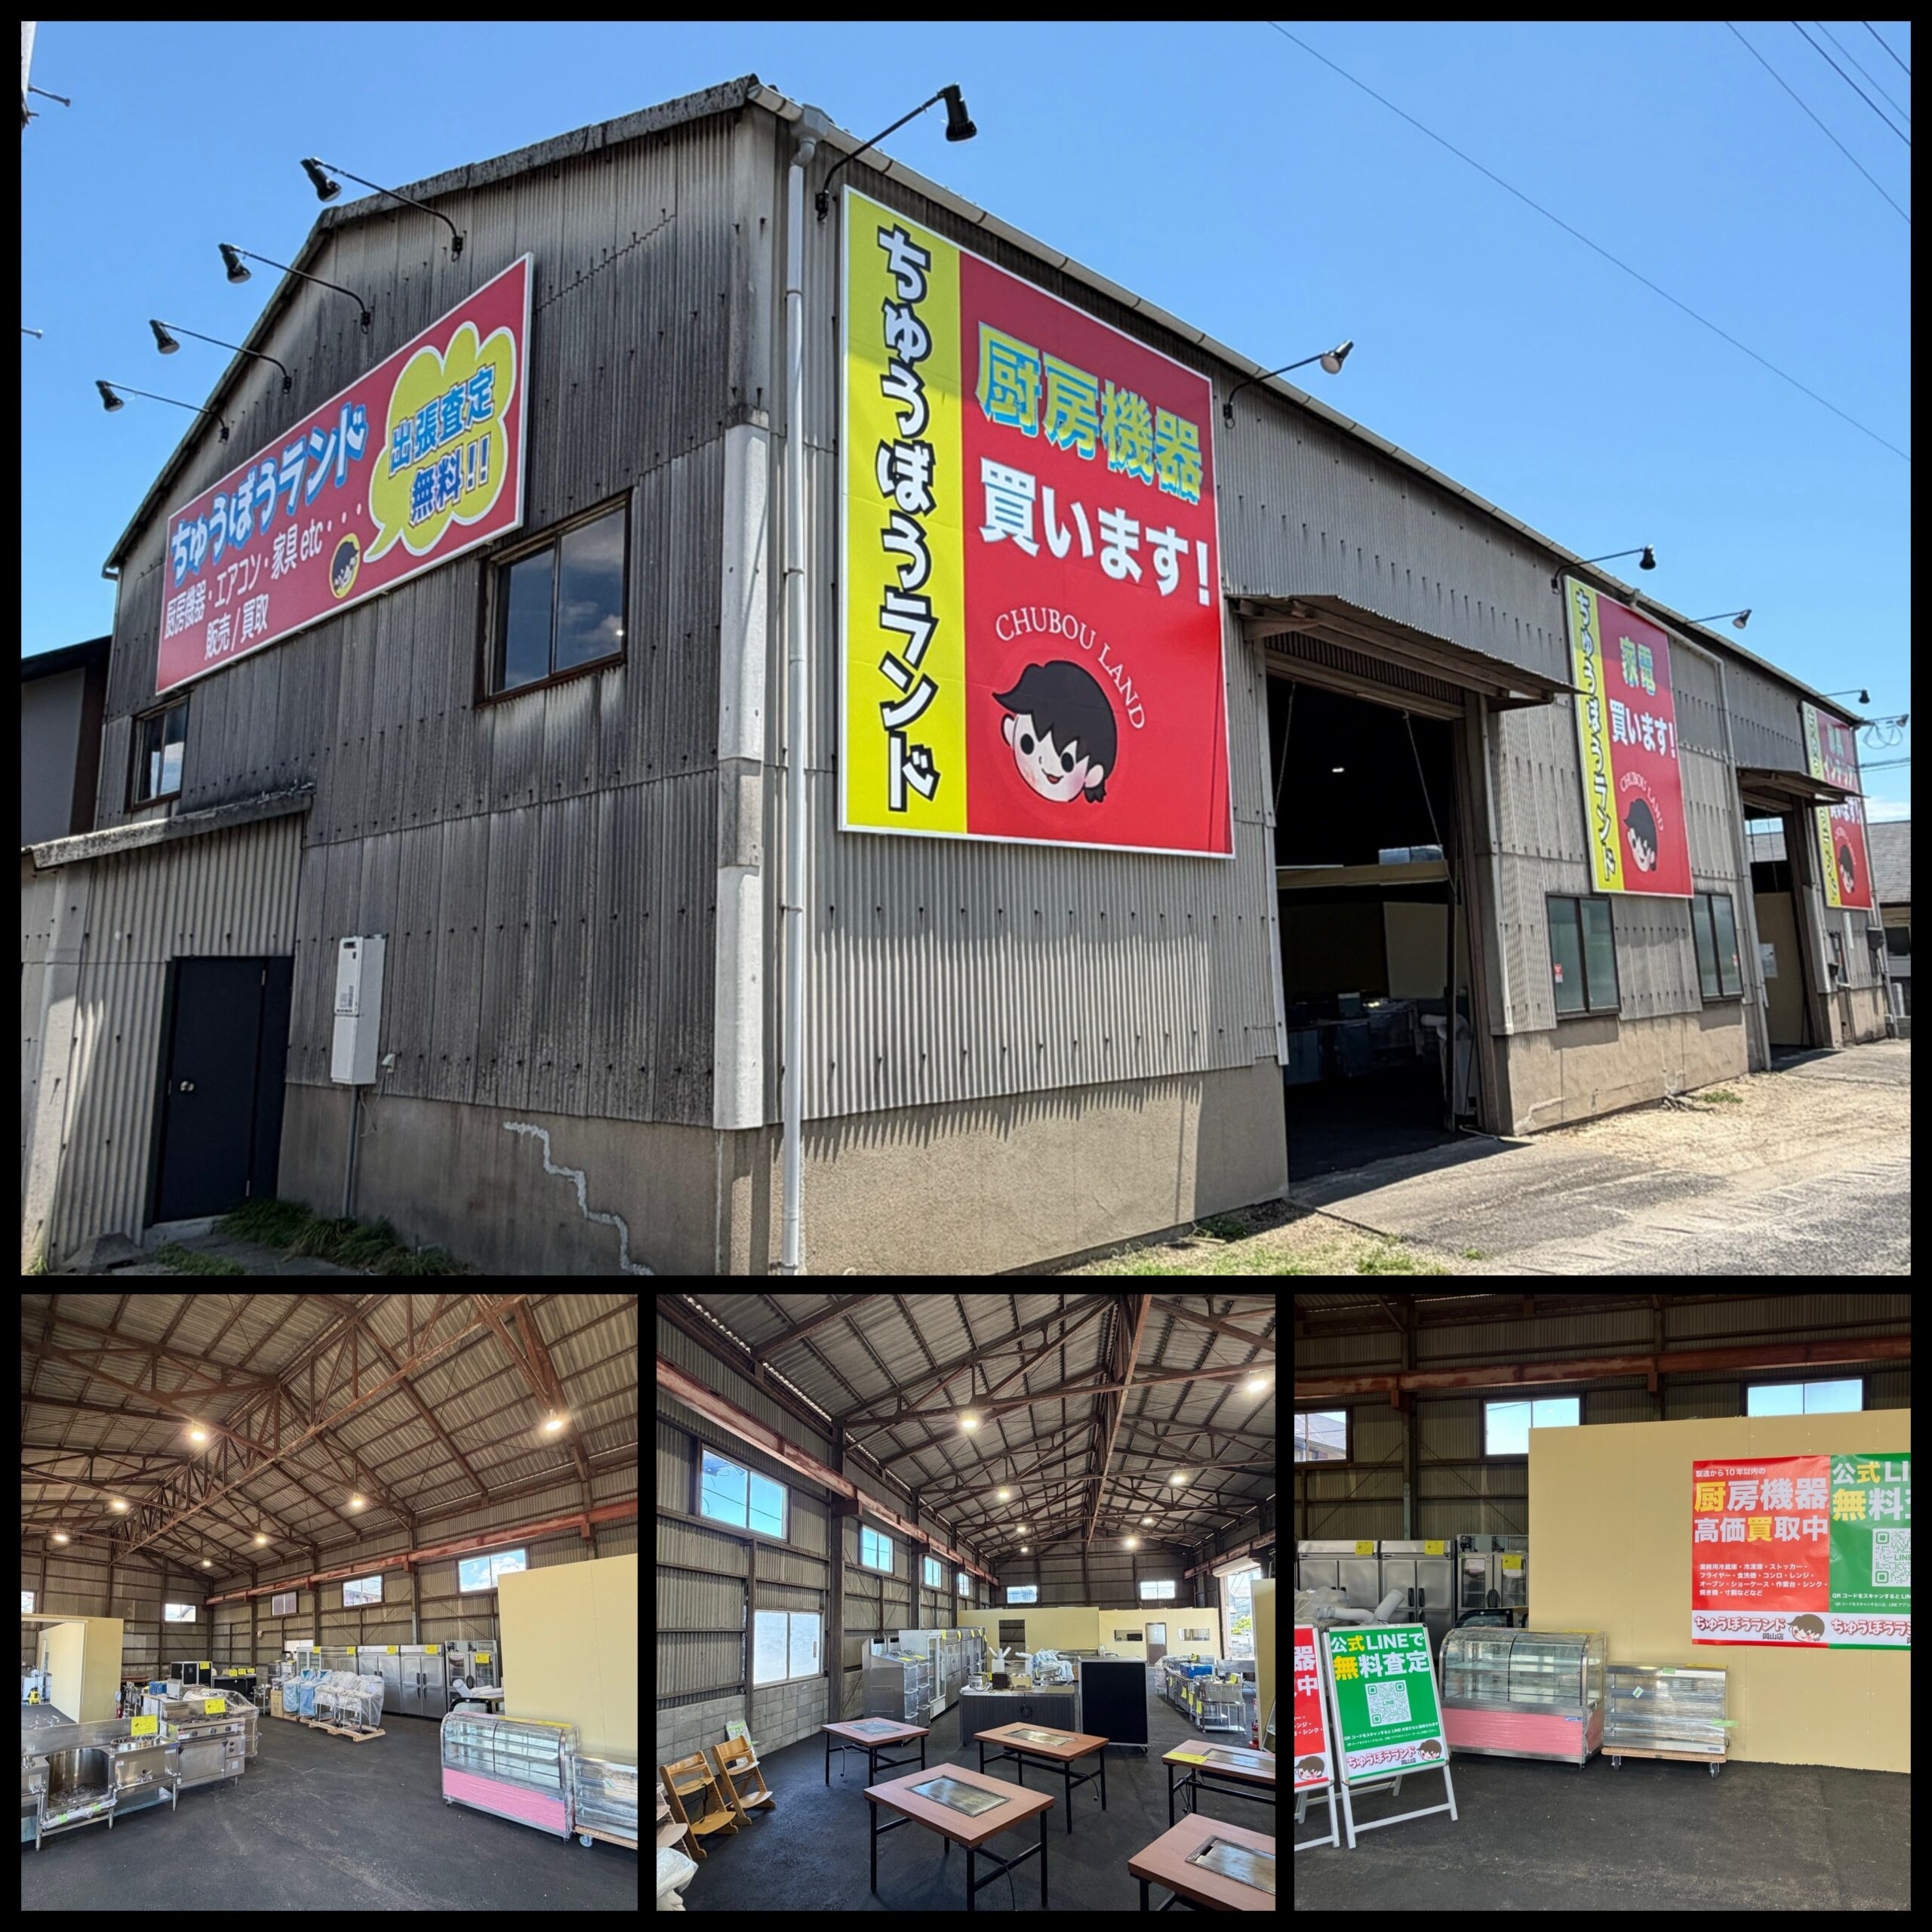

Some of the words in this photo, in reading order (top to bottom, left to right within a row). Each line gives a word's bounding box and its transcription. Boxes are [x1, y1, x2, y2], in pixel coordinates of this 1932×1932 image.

[388, 363, 497, 479] 出張査定
[975, 321, 1204, 506] 厨房機器
[171, 401, 368, 589] ちゅうぼうランド
[876, 223, 941, 814] ちゅうぼうランド
[995, 607, 1096, 650] CHUBOU
[1097, 643, 1146, 731] LAND
[1619, 636, 1657, 697] 家電
[1574, 586, 1617, 883] ちゅうぼうランド
[1694, 1477, 1829, 1512] 厨房機器
[1832, 1487, 1911, 1521] 無料
[1694, 1515, 1829, 1543] 高価買取中
[1694, 1615, 1786, 1632] ちゅうぼうランド
[1332, 1650, 1430, 1681] 無料査定
[1346, 1746, 1417, 1770] ちゅうぼうランド
